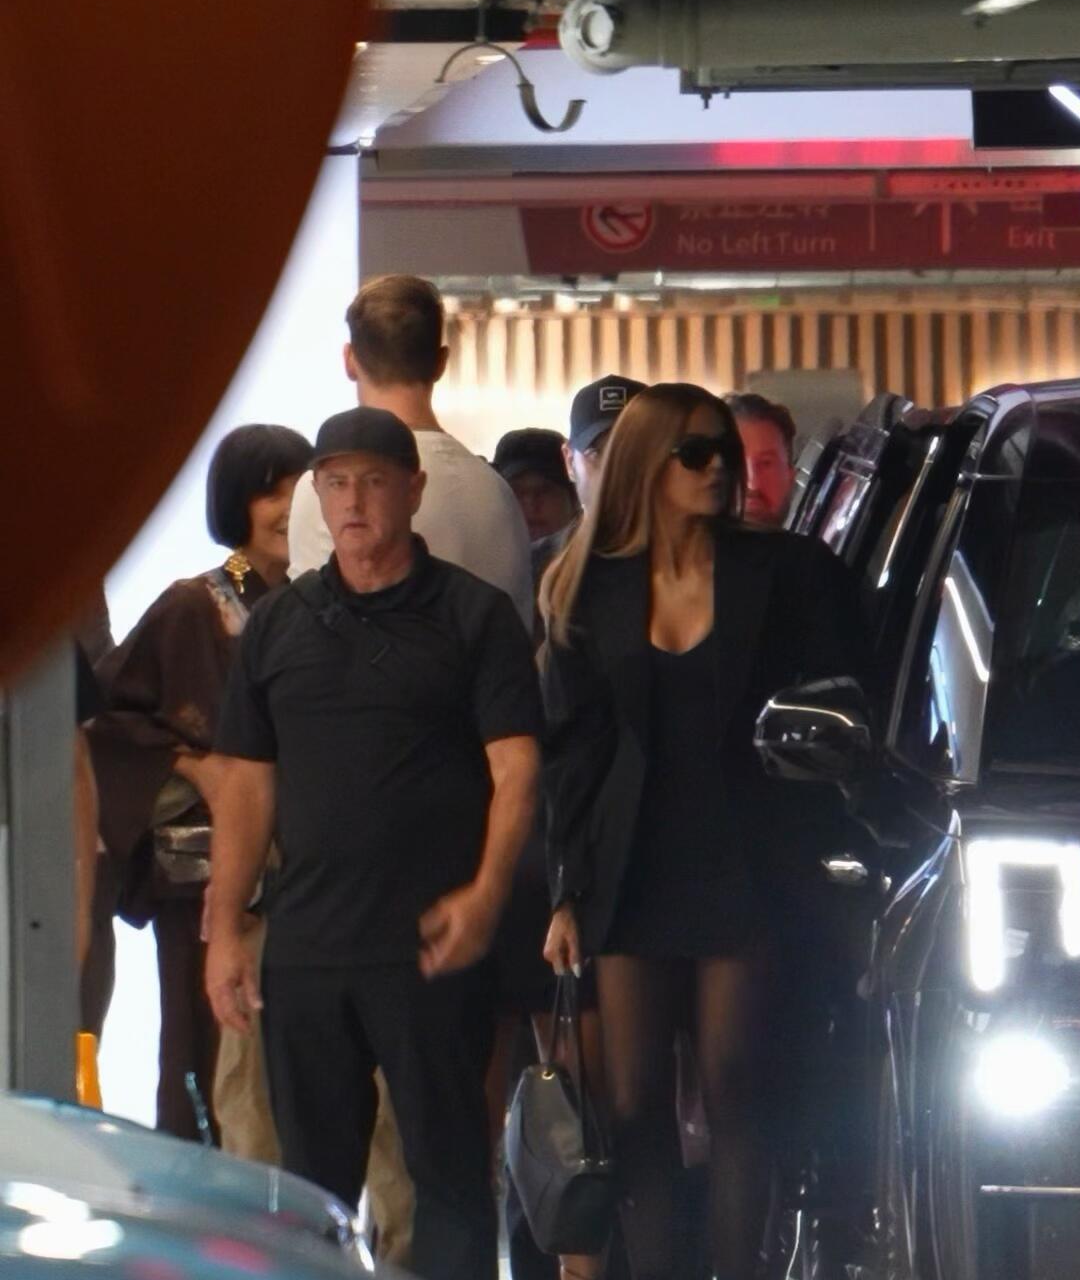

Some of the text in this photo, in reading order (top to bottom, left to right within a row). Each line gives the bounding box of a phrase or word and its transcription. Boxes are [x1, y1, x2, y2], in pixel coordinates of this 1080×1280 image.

[677, 231, 836, 255] No Left Turn
[1008, 228, 1056, 250] Exit
